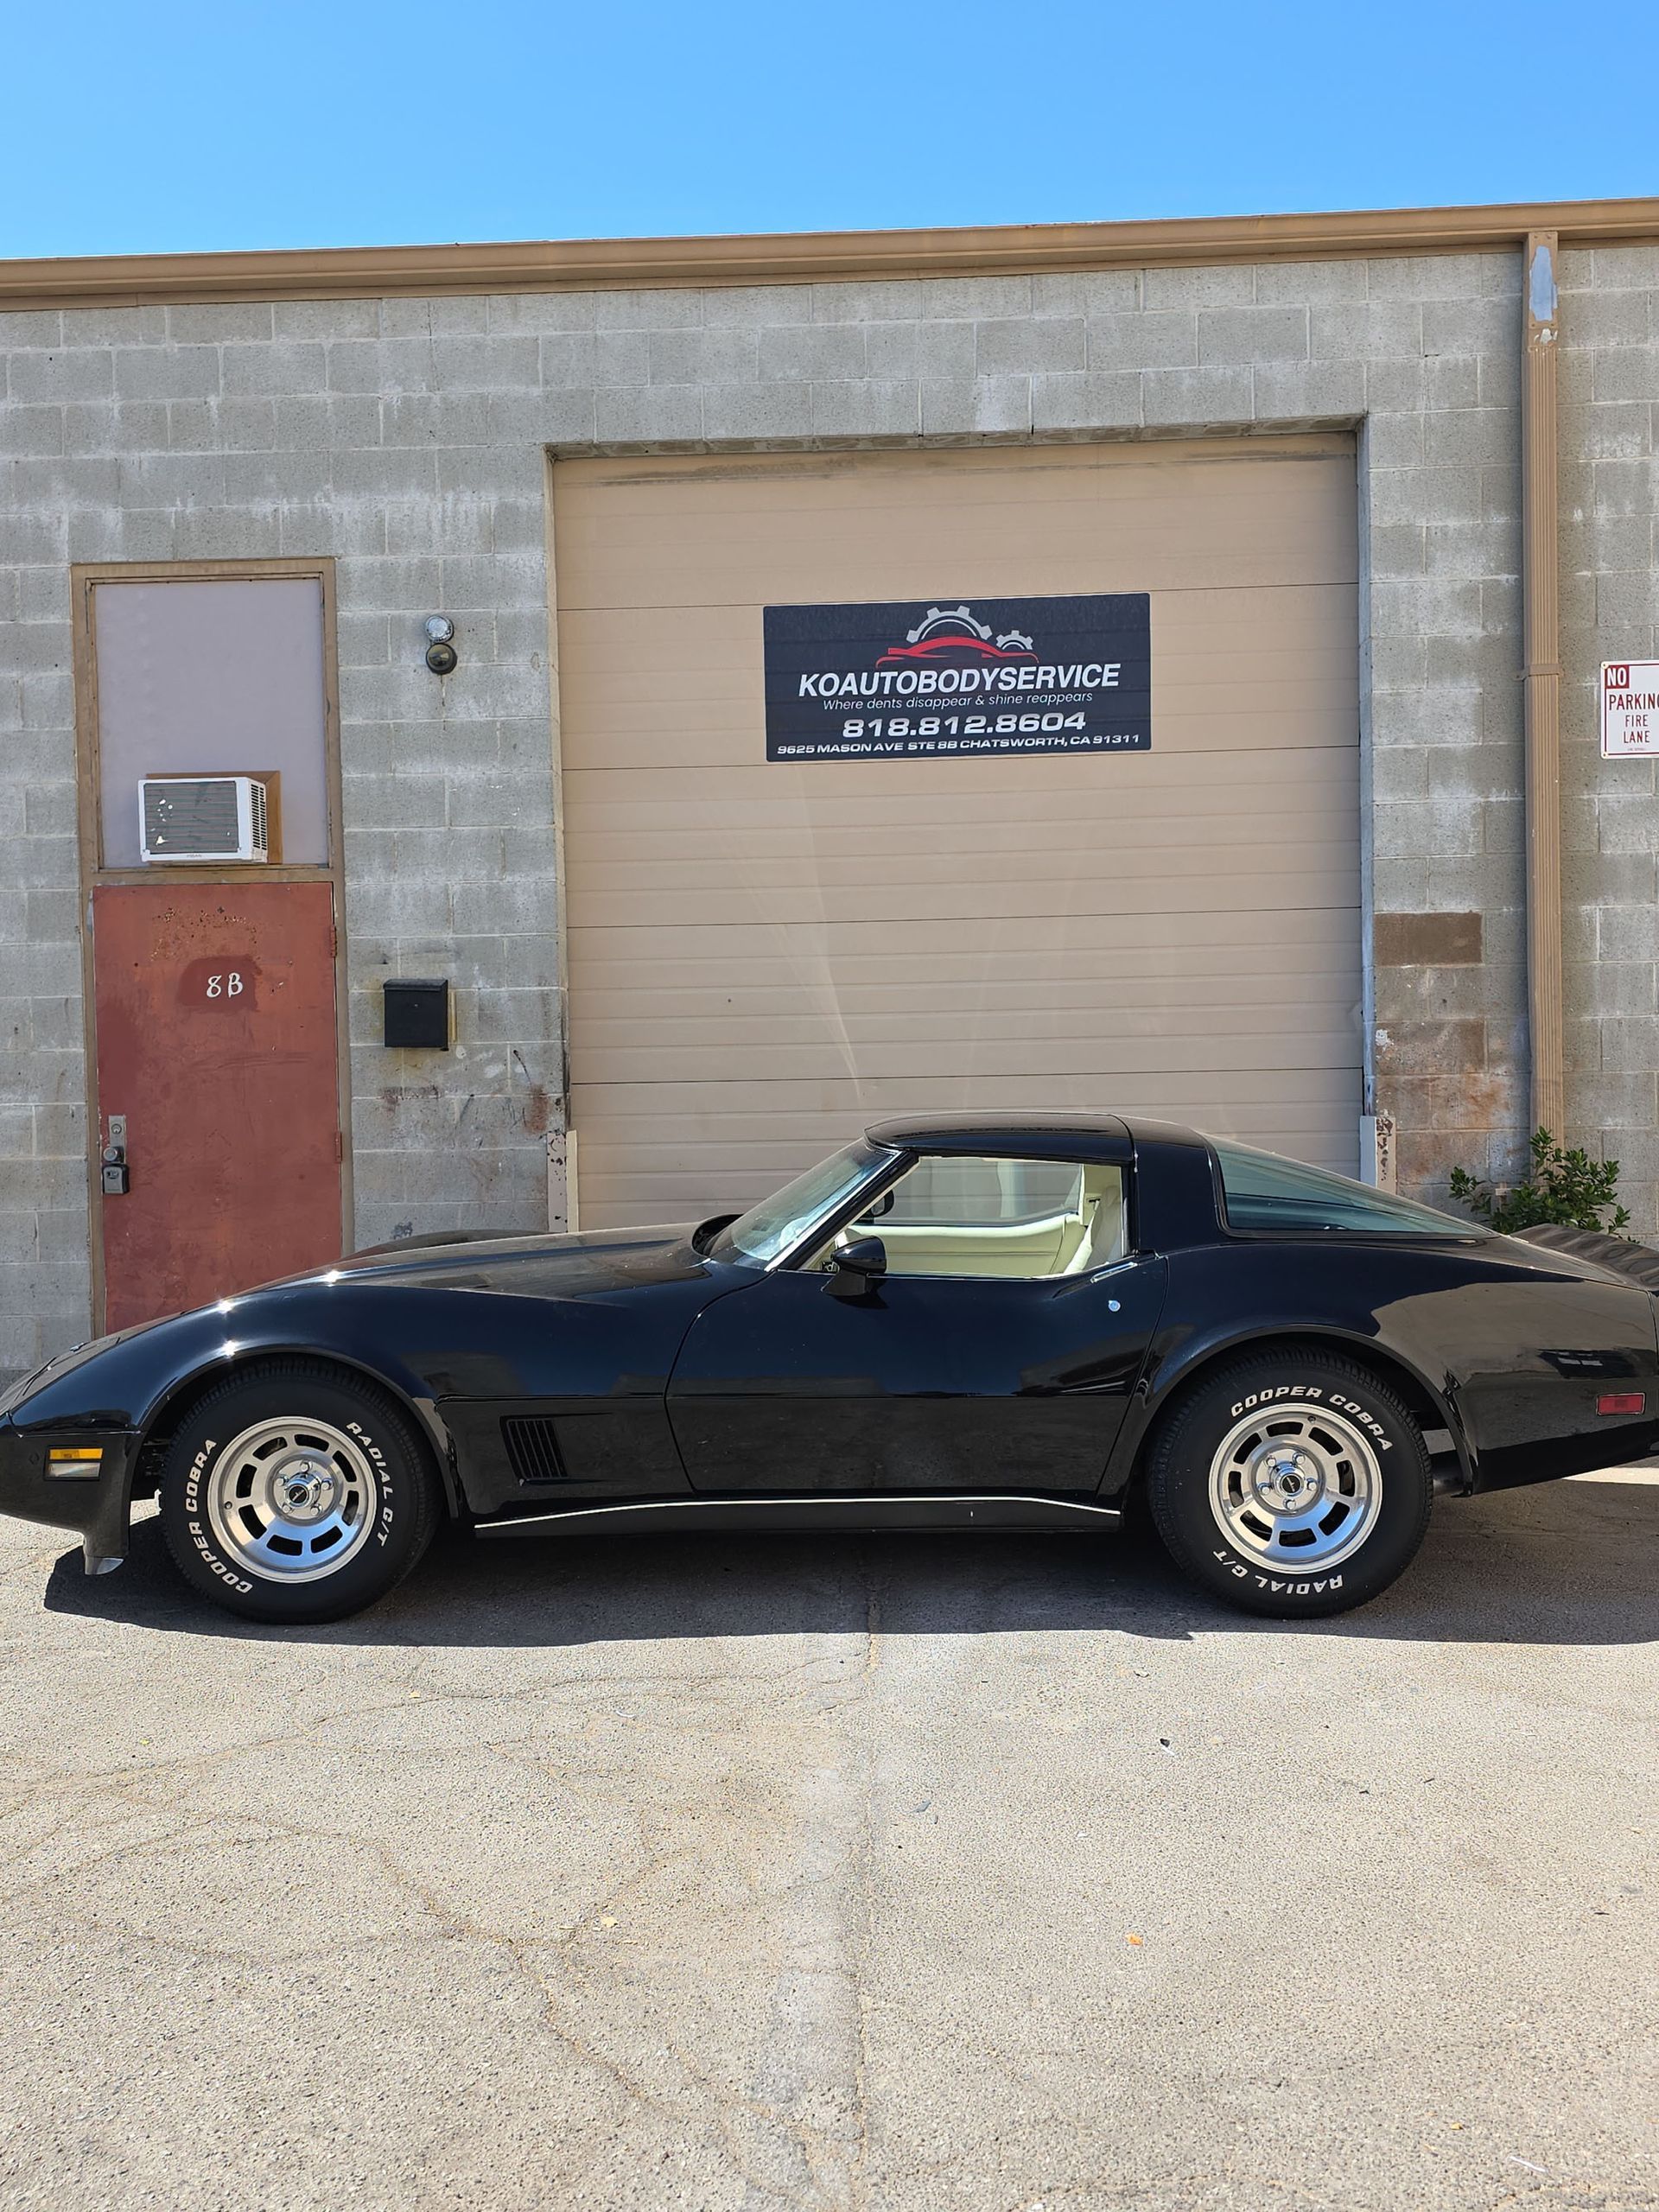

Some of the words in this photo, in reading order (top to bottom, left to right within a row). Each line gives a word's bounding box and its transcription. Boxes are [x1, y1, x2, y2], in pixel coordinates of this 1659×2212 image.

[798, 664, 1122, 696] KOAUTOBODYSERVICE
[1606, 667, 1627, 687] NO
[823, 699, 863, 710] Where
[867, 698, 902, 709] dents
[906, 696, 972, 710] disappear
[975, 695, 985, 705] &
[988, 694, 1023, 705] shine
[1027, 692, 1093, 706] reappears
[842, 712, 1086, 738] 818.812.8604
[1625, 715, 1649, 728] FIRE
[778, 745, 815, 754] 9625
[817, 743, 873, 753] MASON
[873, 743, 904, 752] AVE
[907, 741, 935, 751] STE
[938, 741, 958, 749] 8B
[960, 736, 1068, 748] CHATSWORTH,
[1070, 735, 1091, 745] CA
[1093, 734, 1140, 744] 91311
[1624, 731, 1650, 743] LANE
[1230, 1386, 1323, 1417] COOPER
[1329, 1394, 1393, 1451] COBRA
[186, 1439, 217, 1512] COBRA
[346, 1421, 393, 1499] RADIAL
[377, 1507, 393, 1547] G/T
[188, 1522, 253, 1593] COOPER
[1213, 1549, 1249, 1579] G/T
[1255, 1574, 1344, 1594] RADIAL
